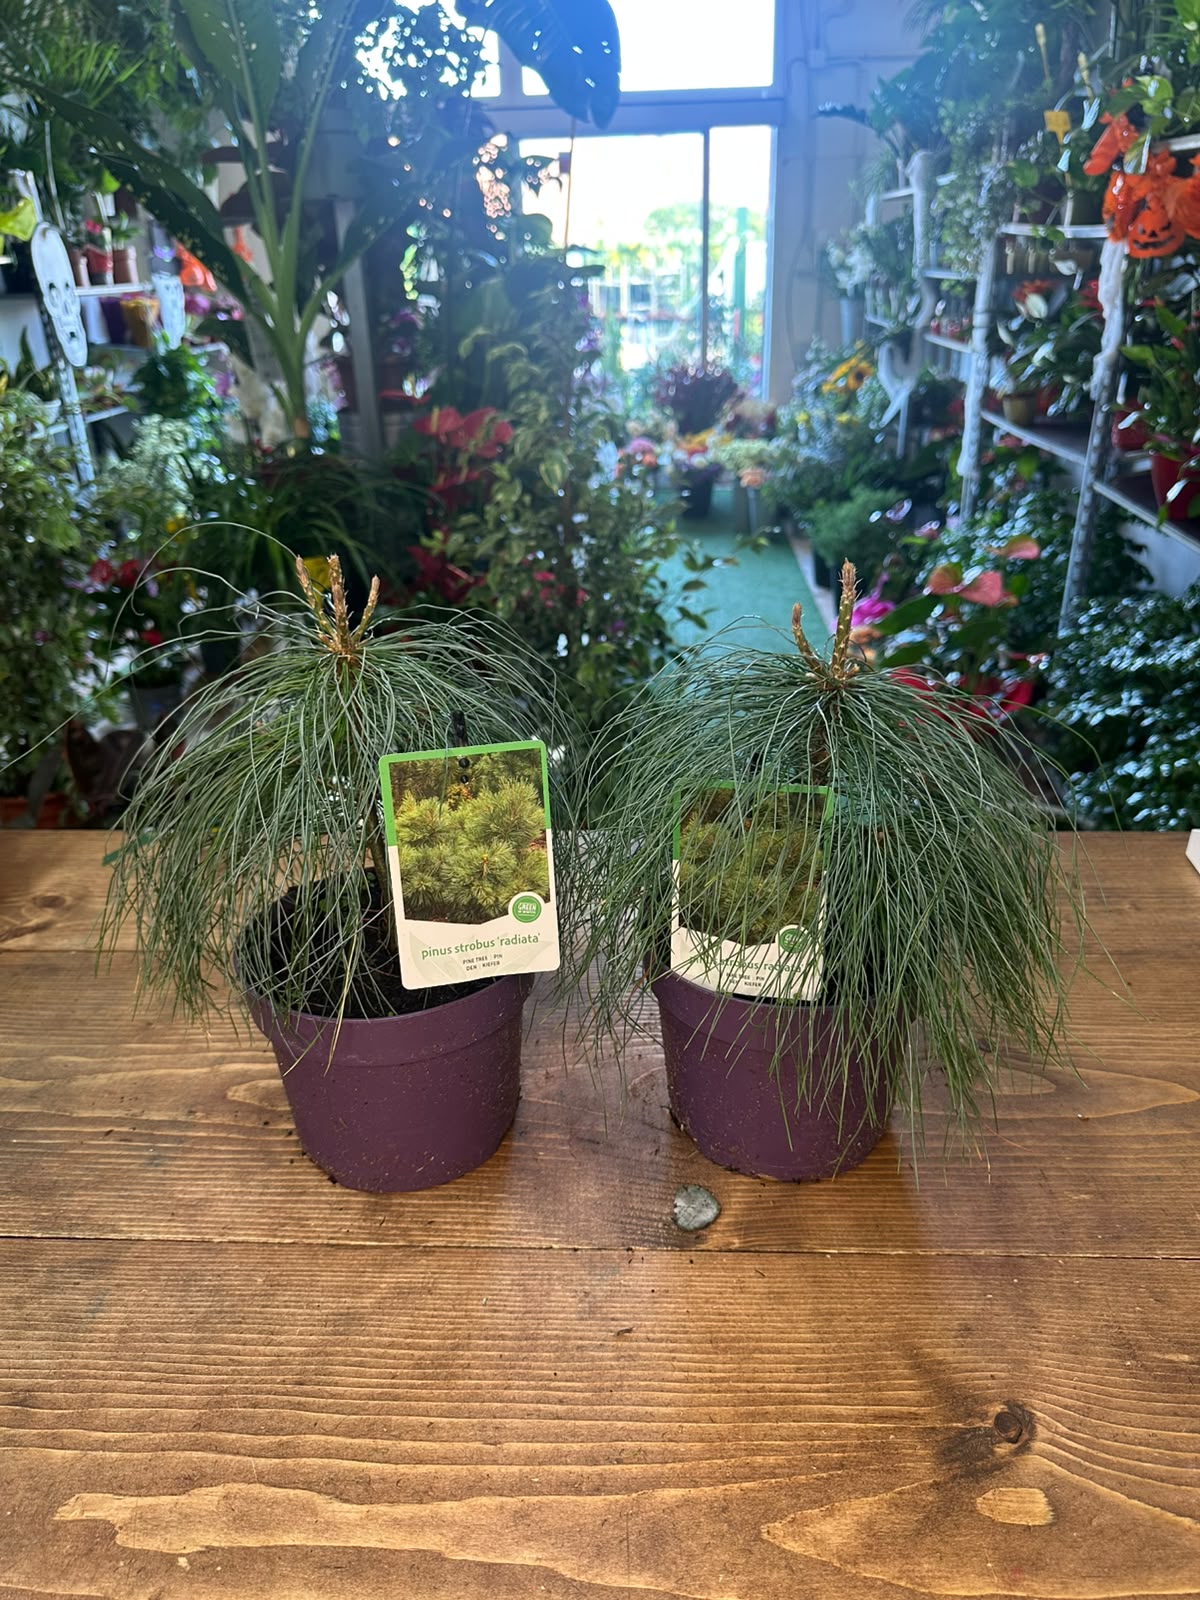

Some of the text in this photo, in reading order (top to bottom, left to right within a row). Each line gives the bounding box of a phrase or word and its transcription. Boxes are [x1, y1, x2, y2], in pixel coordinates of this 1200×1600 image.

[421, 932, 541, 960] pinus strobus 'radiata'
[462, 953, 503, 965] PINE TREE PIN
[465, 960, 500, 972] DEN KIEFER
